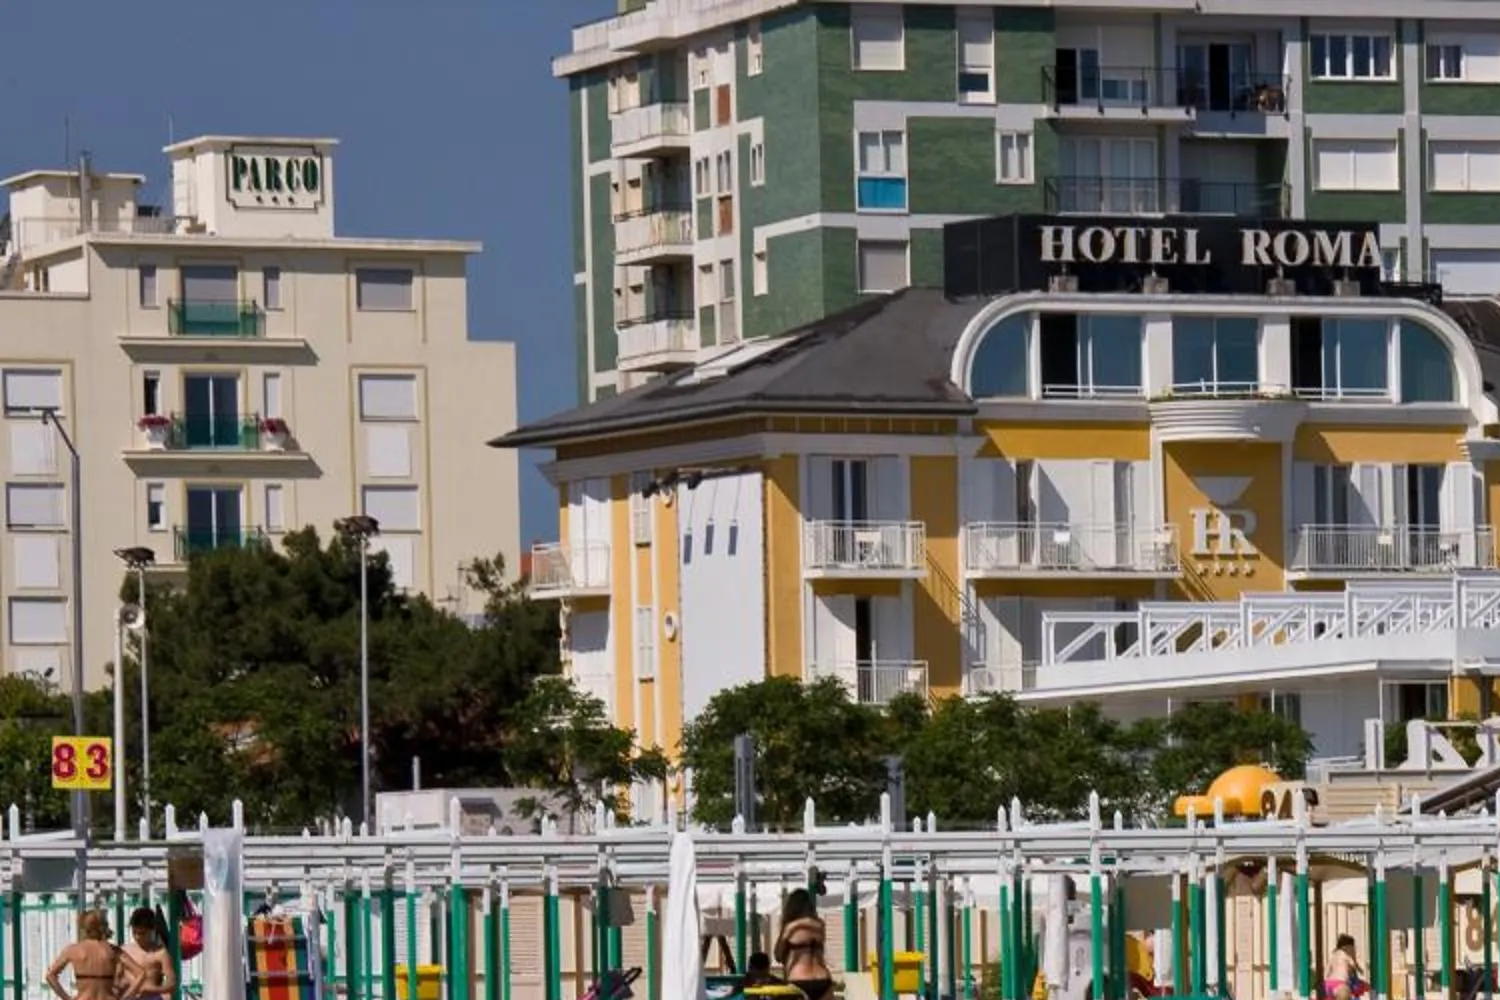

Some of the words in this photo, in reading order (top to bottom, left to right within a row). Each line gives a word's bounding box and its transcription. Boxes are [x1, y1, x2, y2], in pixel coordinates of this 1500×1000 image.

[232, 156, 318, 193] PARCO
[1040, 226, 1211, 264] HOTEL
[1242, 229, 1382, 267] ROMA
[54, 744, 108, 778] 83
